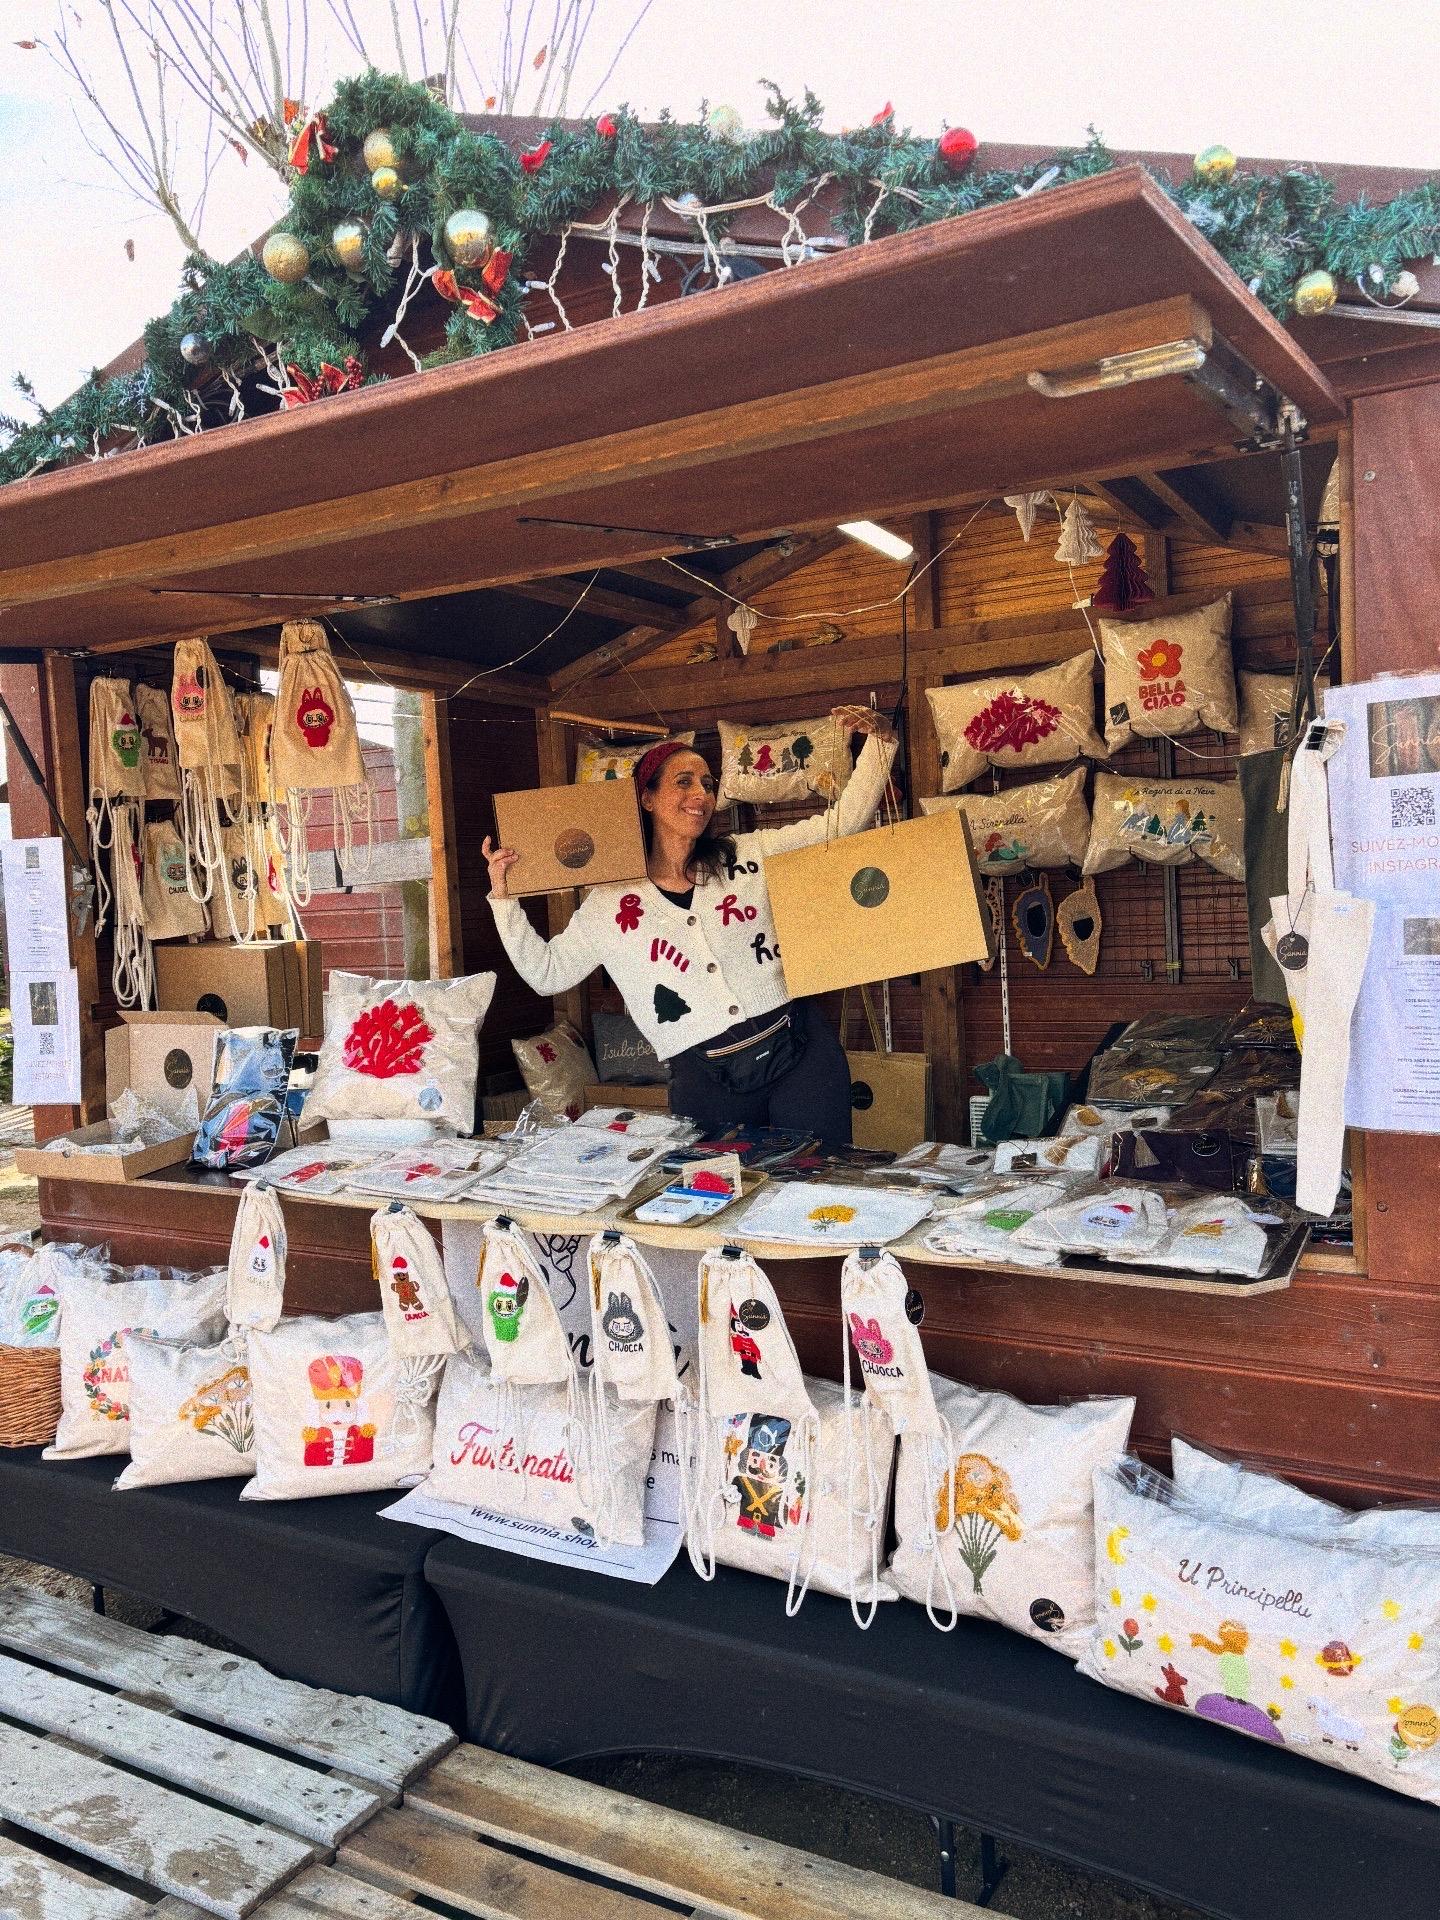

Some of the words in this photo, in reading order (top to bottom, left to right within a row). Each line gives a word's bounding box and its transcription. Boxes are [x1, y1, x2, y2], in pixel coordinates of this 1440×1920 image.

[1139, 680, 1186, 699] BELLA
[1143, 693, 1185, 711] CIAO
[1141, 787, 1172, 798] Regina
[1175, 787, 1184, 795] di
[1194, 786, 1216, 795] Neve
[726, 853, 758, 880] ho
[715, 894, 757, 926] ho
[602, 1039, 636, 1060] Isula
[609, 1340, 644, 1352] CHJOCCA
[862, 1360, 904, 1378] CHJOCCA
[1207, 1566, 1312, 1618] Principellu
